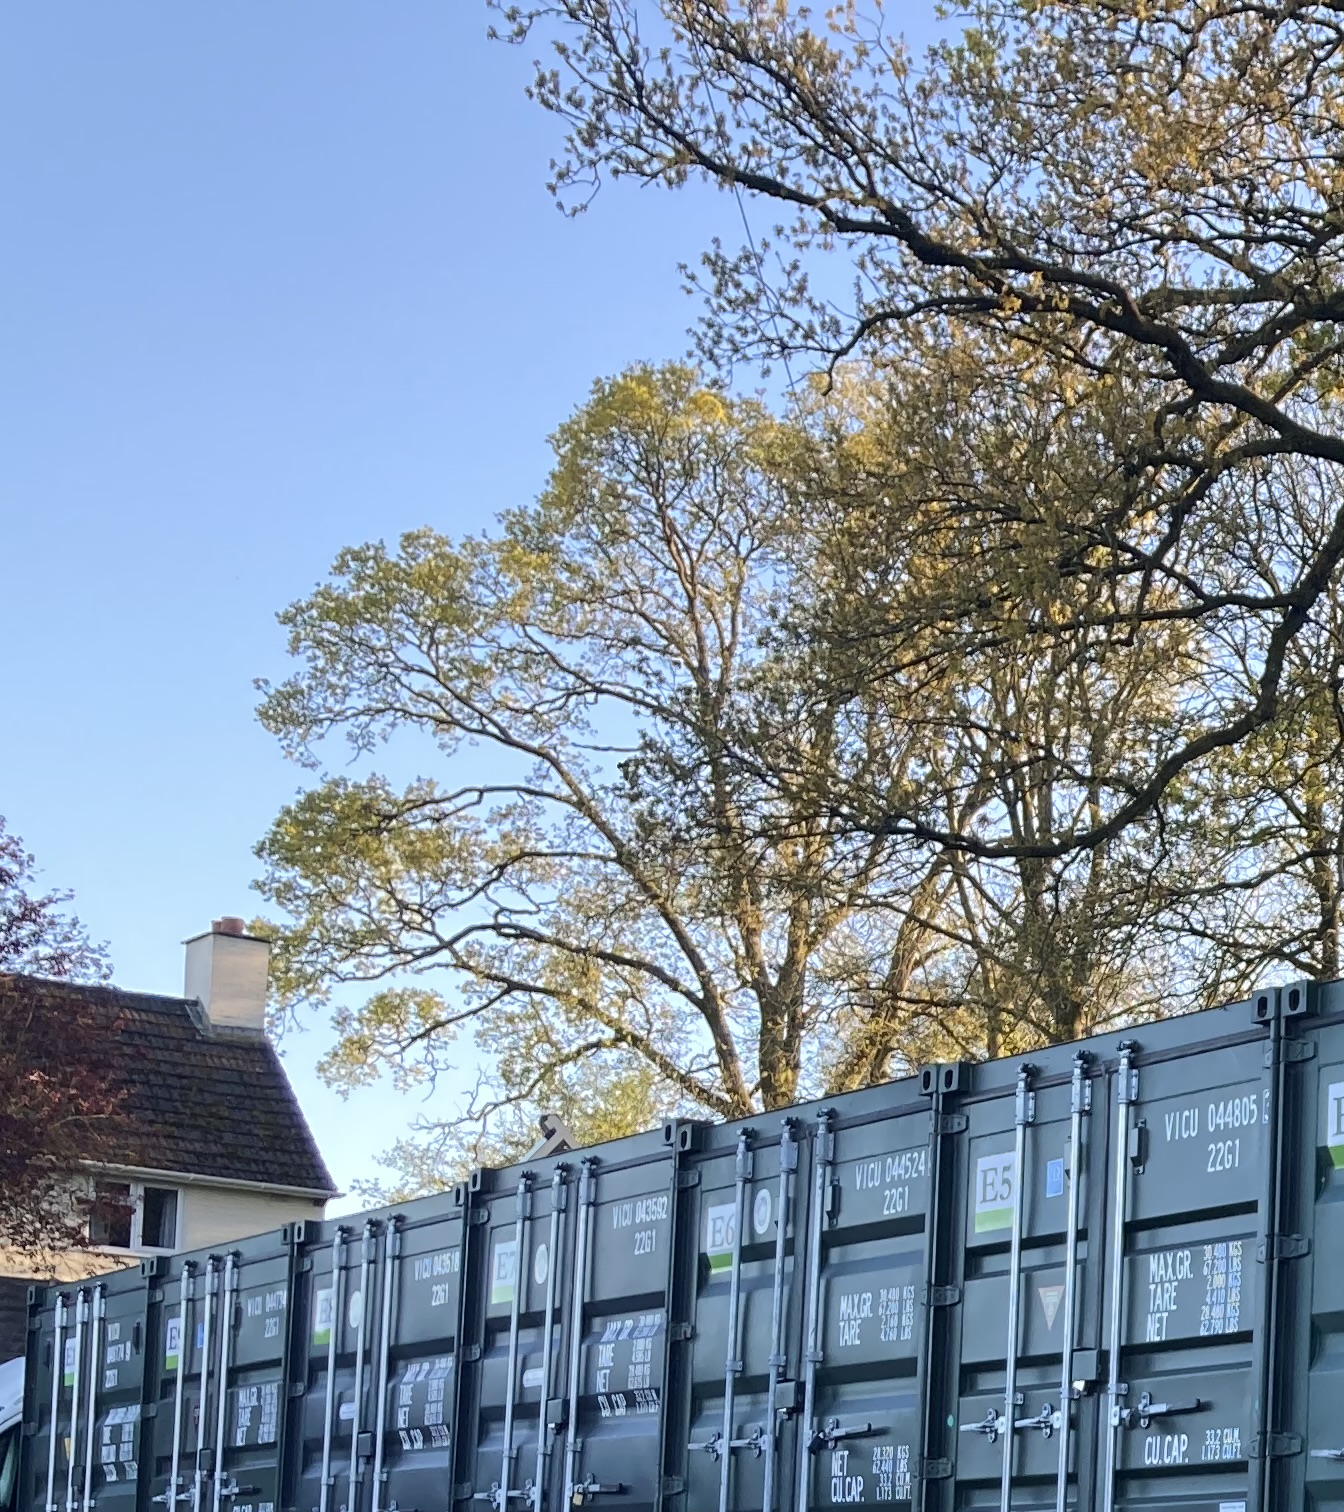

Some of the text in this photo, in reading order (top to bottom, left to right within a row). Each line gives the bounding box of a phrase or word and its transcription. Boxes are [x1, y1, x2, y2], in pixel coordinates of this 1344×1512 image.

[1164, 1107, 1199, 1142] VICU
[1207, 1094, 1258, 1132] 044805
[855, 1149, 926, 1191] VICU 044524
[1207, 1138, 1240, 1173] 22G1
[883, 1184, 909, 1215] 22G1
[979, 1164, 1013, 1204] E5
[710, 1212, 735, 1248] E6
[1149, 1281, 1178, 1313] TARE
[839, 1319, 861, 1347] TARE
[1146, 1312, 1169, 1342] NET
[831, 1450, 849, 1477] NET
